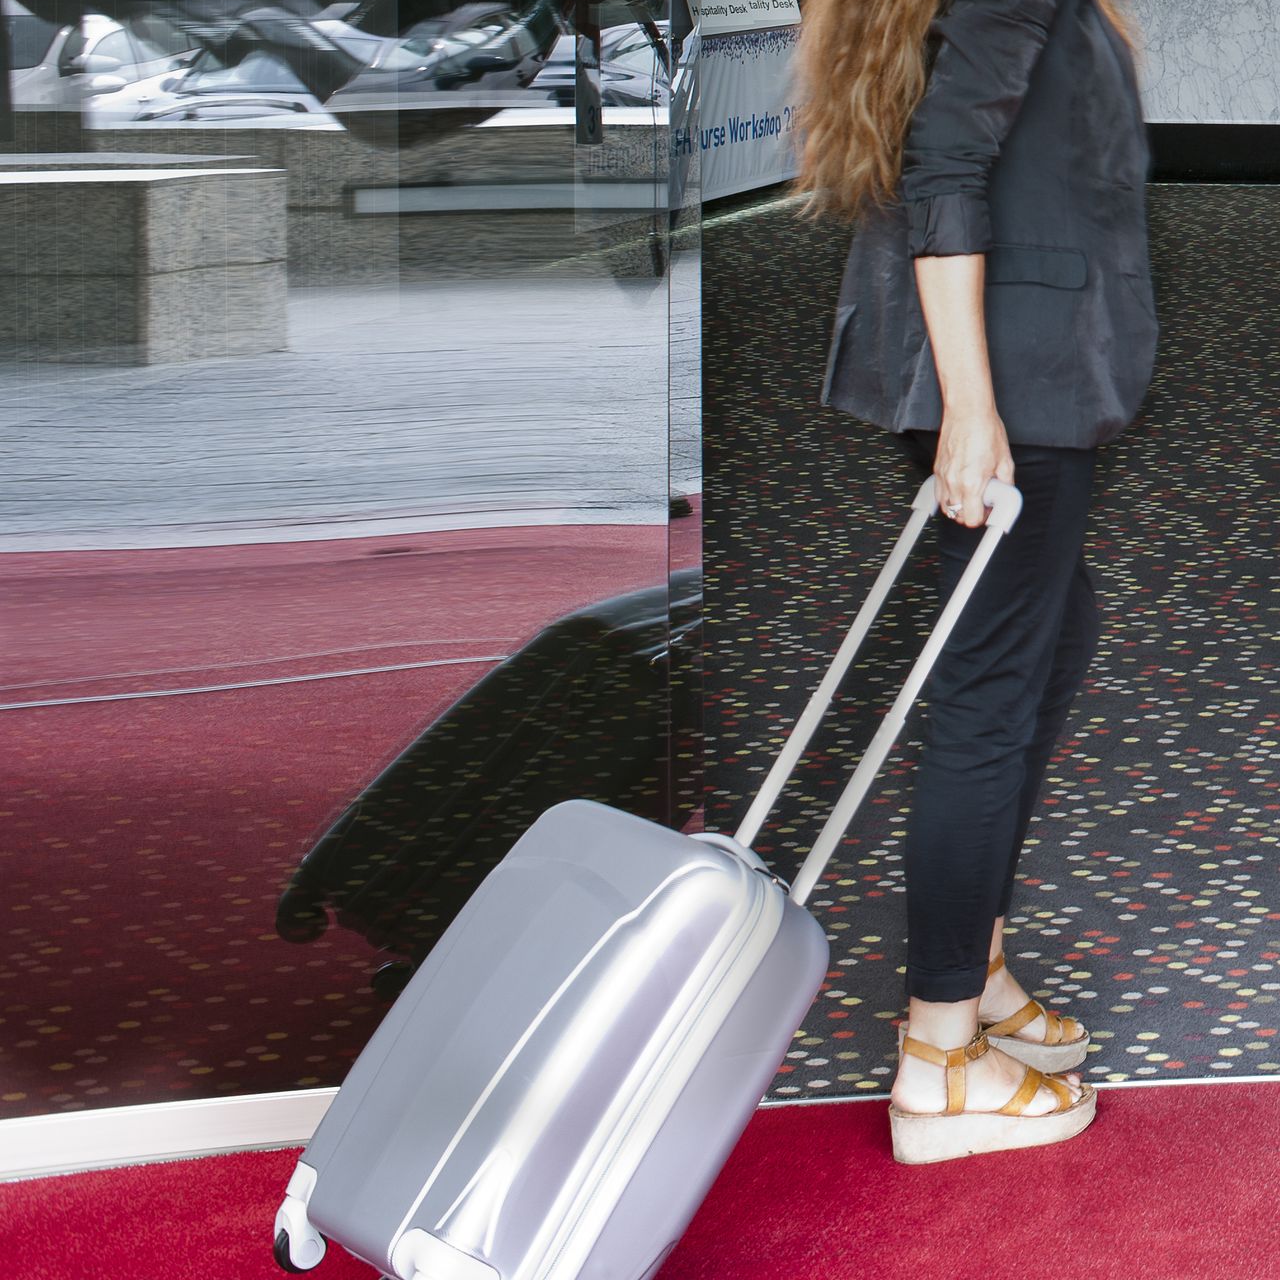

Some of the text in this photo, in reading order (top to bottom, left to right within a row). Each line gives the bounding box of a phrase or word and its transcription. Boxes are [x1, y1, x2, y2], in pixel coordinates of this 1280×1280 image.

[729, 4, 748, 15] Desk
[772, 0, 795, 9] Desk
[695, 125, 726, 151] urse
[728, 112, 782, 145] Workshop
